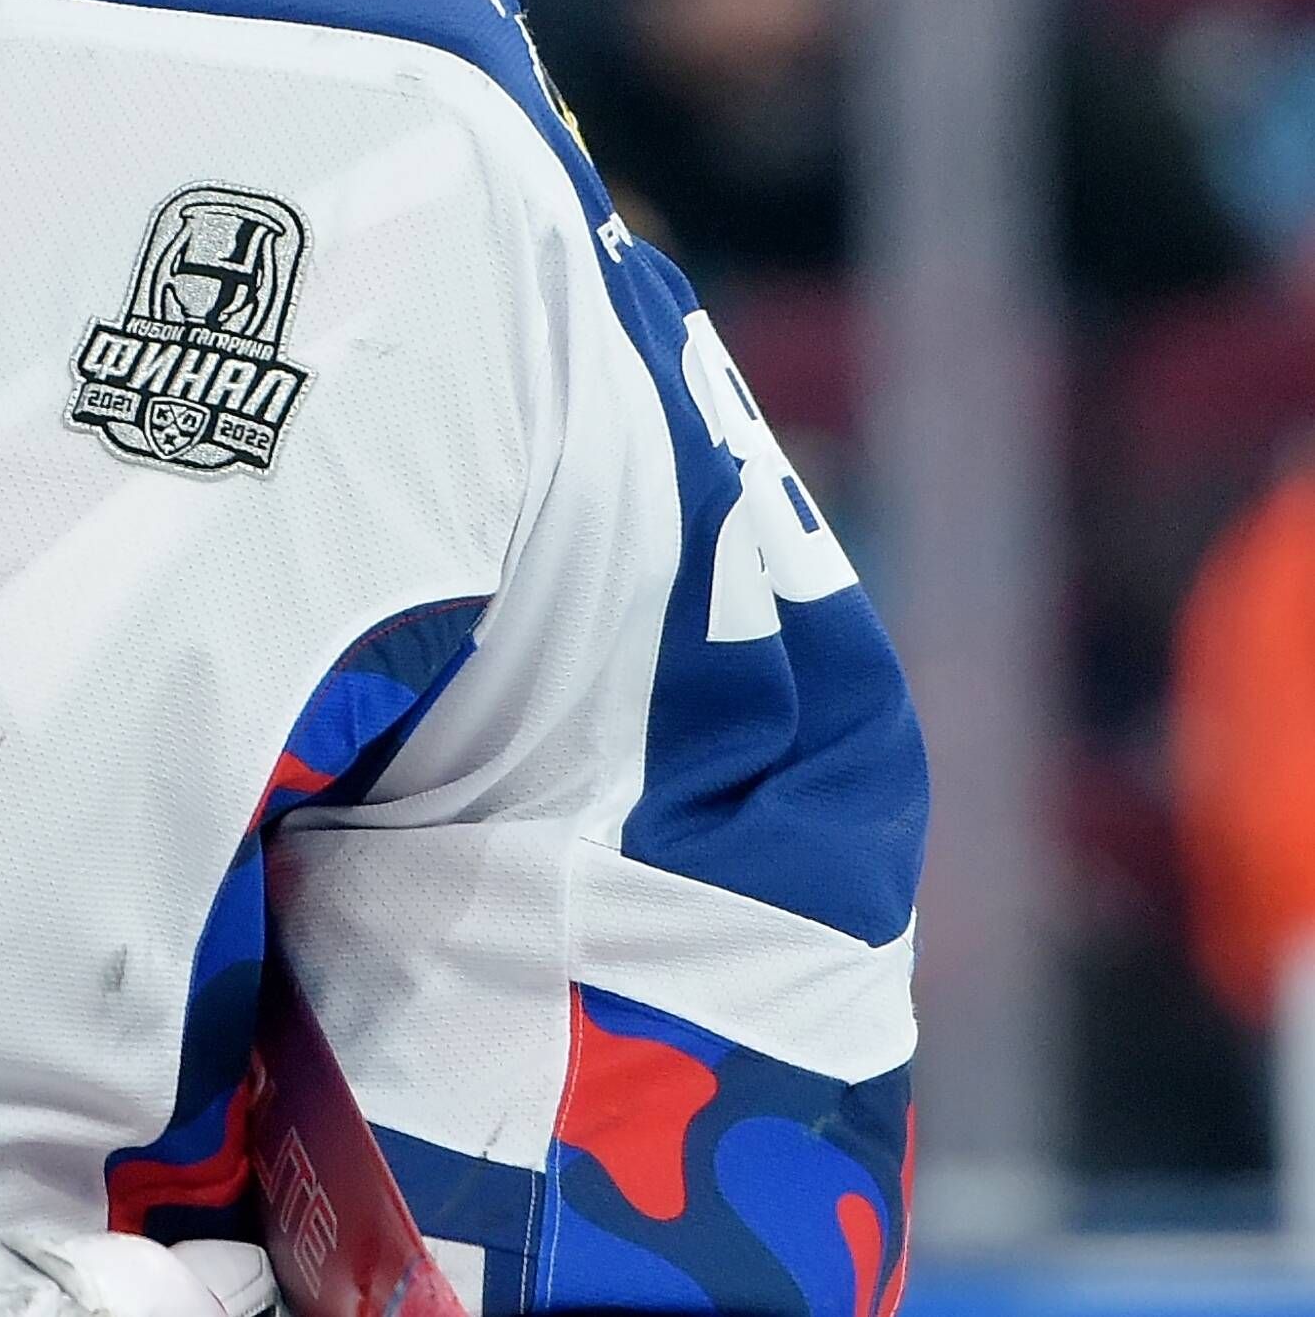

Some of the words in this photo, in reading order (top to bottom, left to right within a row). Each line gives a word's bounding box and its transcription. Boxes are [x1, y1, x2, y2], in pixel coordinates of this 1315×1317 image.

[125, 318, 186, 342] КУБОК
[187, 327, 275, 361] ГАГАРИНА
[82, 331, 299, 423] ФИНАЛ
[87, 389, 132, 413] 2021
[220, 419, 270, 450] 2022
